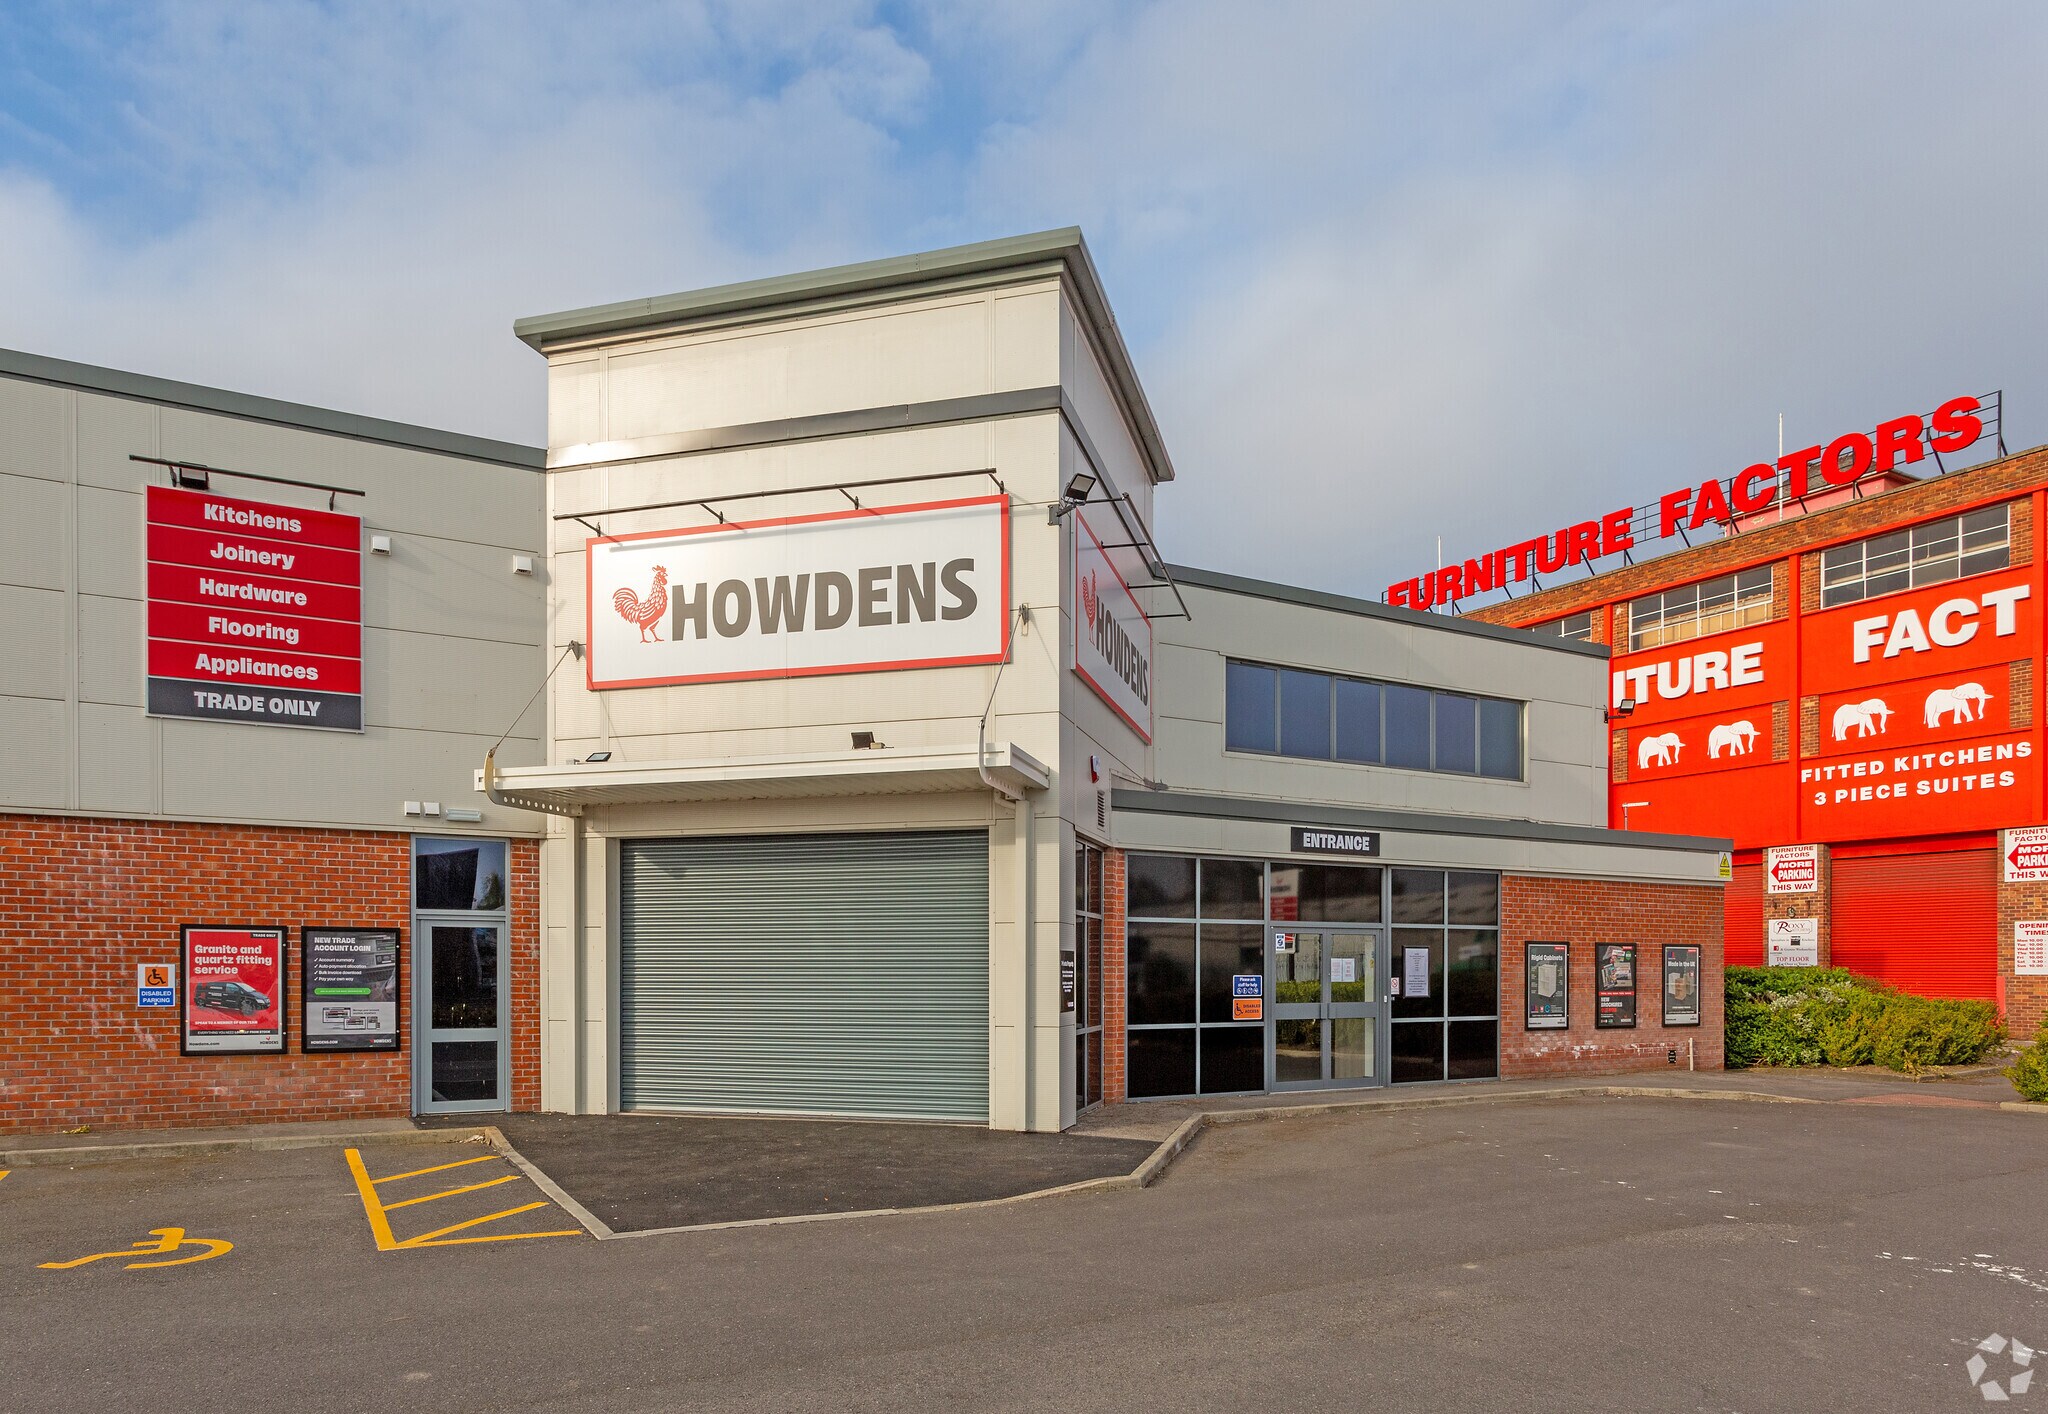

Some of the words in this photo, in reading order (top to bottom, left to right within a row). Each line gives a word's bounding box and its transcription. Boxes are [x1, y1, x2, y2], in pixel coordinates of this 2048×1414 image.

[204, 503, 302, 532] Kitchens
[1388, 507, 1634, 611] FURNITURE
[1660, 396, 1983, 539] FACTORS
[210, 542, 295, 570] Joinery
[199, 578, 307, 606] Hardware
[671, 558, 979, 642] HOWDENS
[208, 616, 299, 645] Flooring
[1852, 584, 2031, 664] FACT
[1096, 595, 1148, 706] HOWDENS
[195, 654, 318, 681] Appliances
[194, 691, 264, 713] TRADE
[269, 698, 321, 717] ONLY
[1801, 760, 1884, 783] FITTED
[1894, 741, 2032, 772] KITCHENS
[1814, 792, 1827, 805] 3
[1835, 783, 1907, 804] PIECE
[1916, 771, 2015, 795] SUITES
[1303, 832, 1370, 851] ENTRANCE
[1778, 868, 1813, 880] PARKING
[1779, 861, 1812, 869] MORE
[2009, 871, 2036, 879] THIS
[194, 944, 238, 954] Granite
[240, 945, 262, 954] and
[194, 955, 234, 965] quartz
[236, 955, 272, 966] fitting
[194, 965, 238, 974] service
